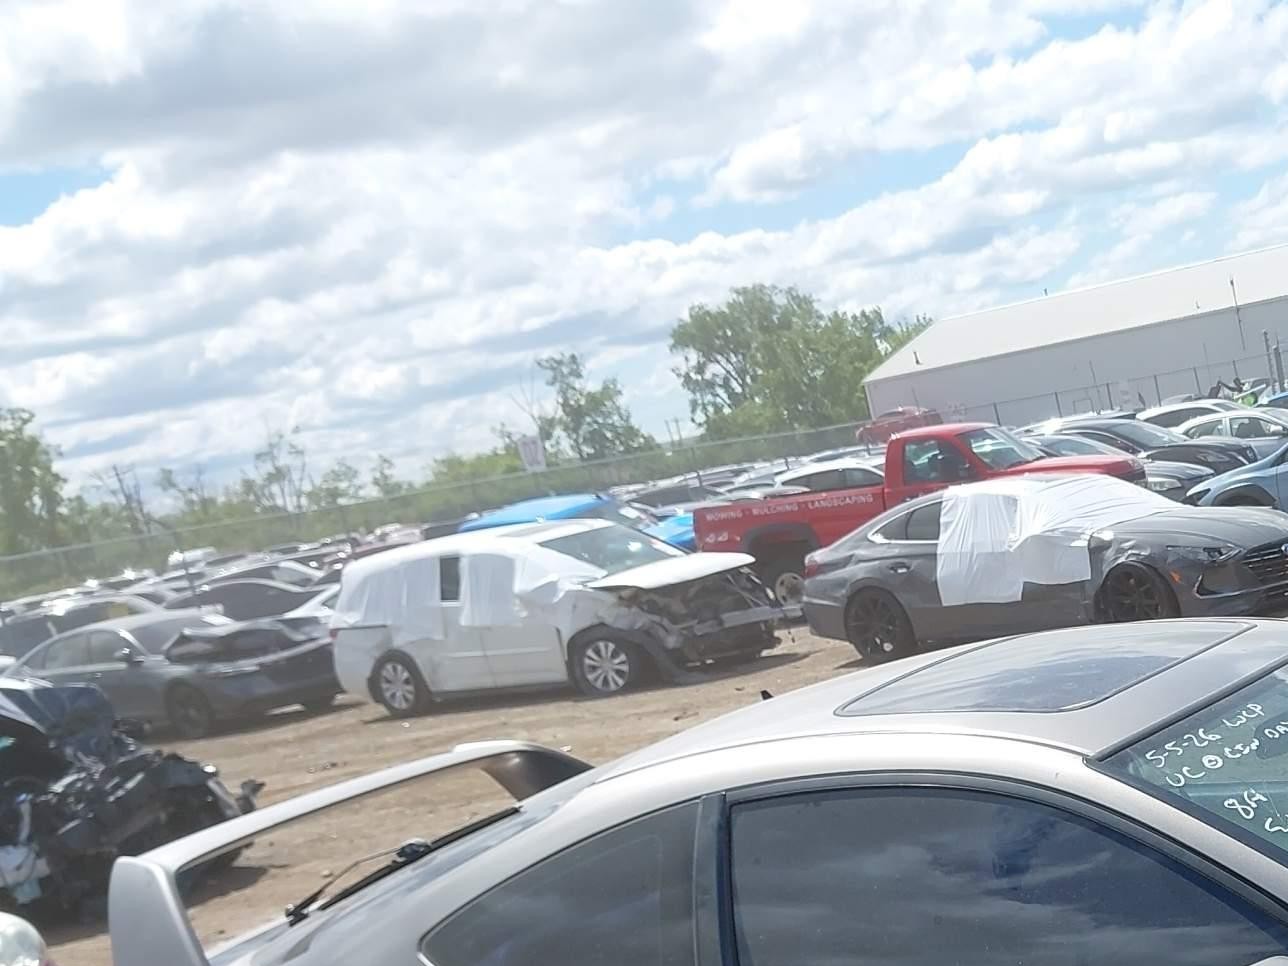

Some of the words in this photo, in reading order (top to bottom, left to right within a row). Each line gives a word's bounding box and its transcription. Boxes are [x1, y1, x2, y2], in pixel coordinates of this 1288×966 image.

[706, 510, 743, 521] MOWING
[752, 501, 799, 516] MULCHING
[808, 494, 874, 510] LANDSCAPING
[1145, 728, 1222, 768] 5-5-26
